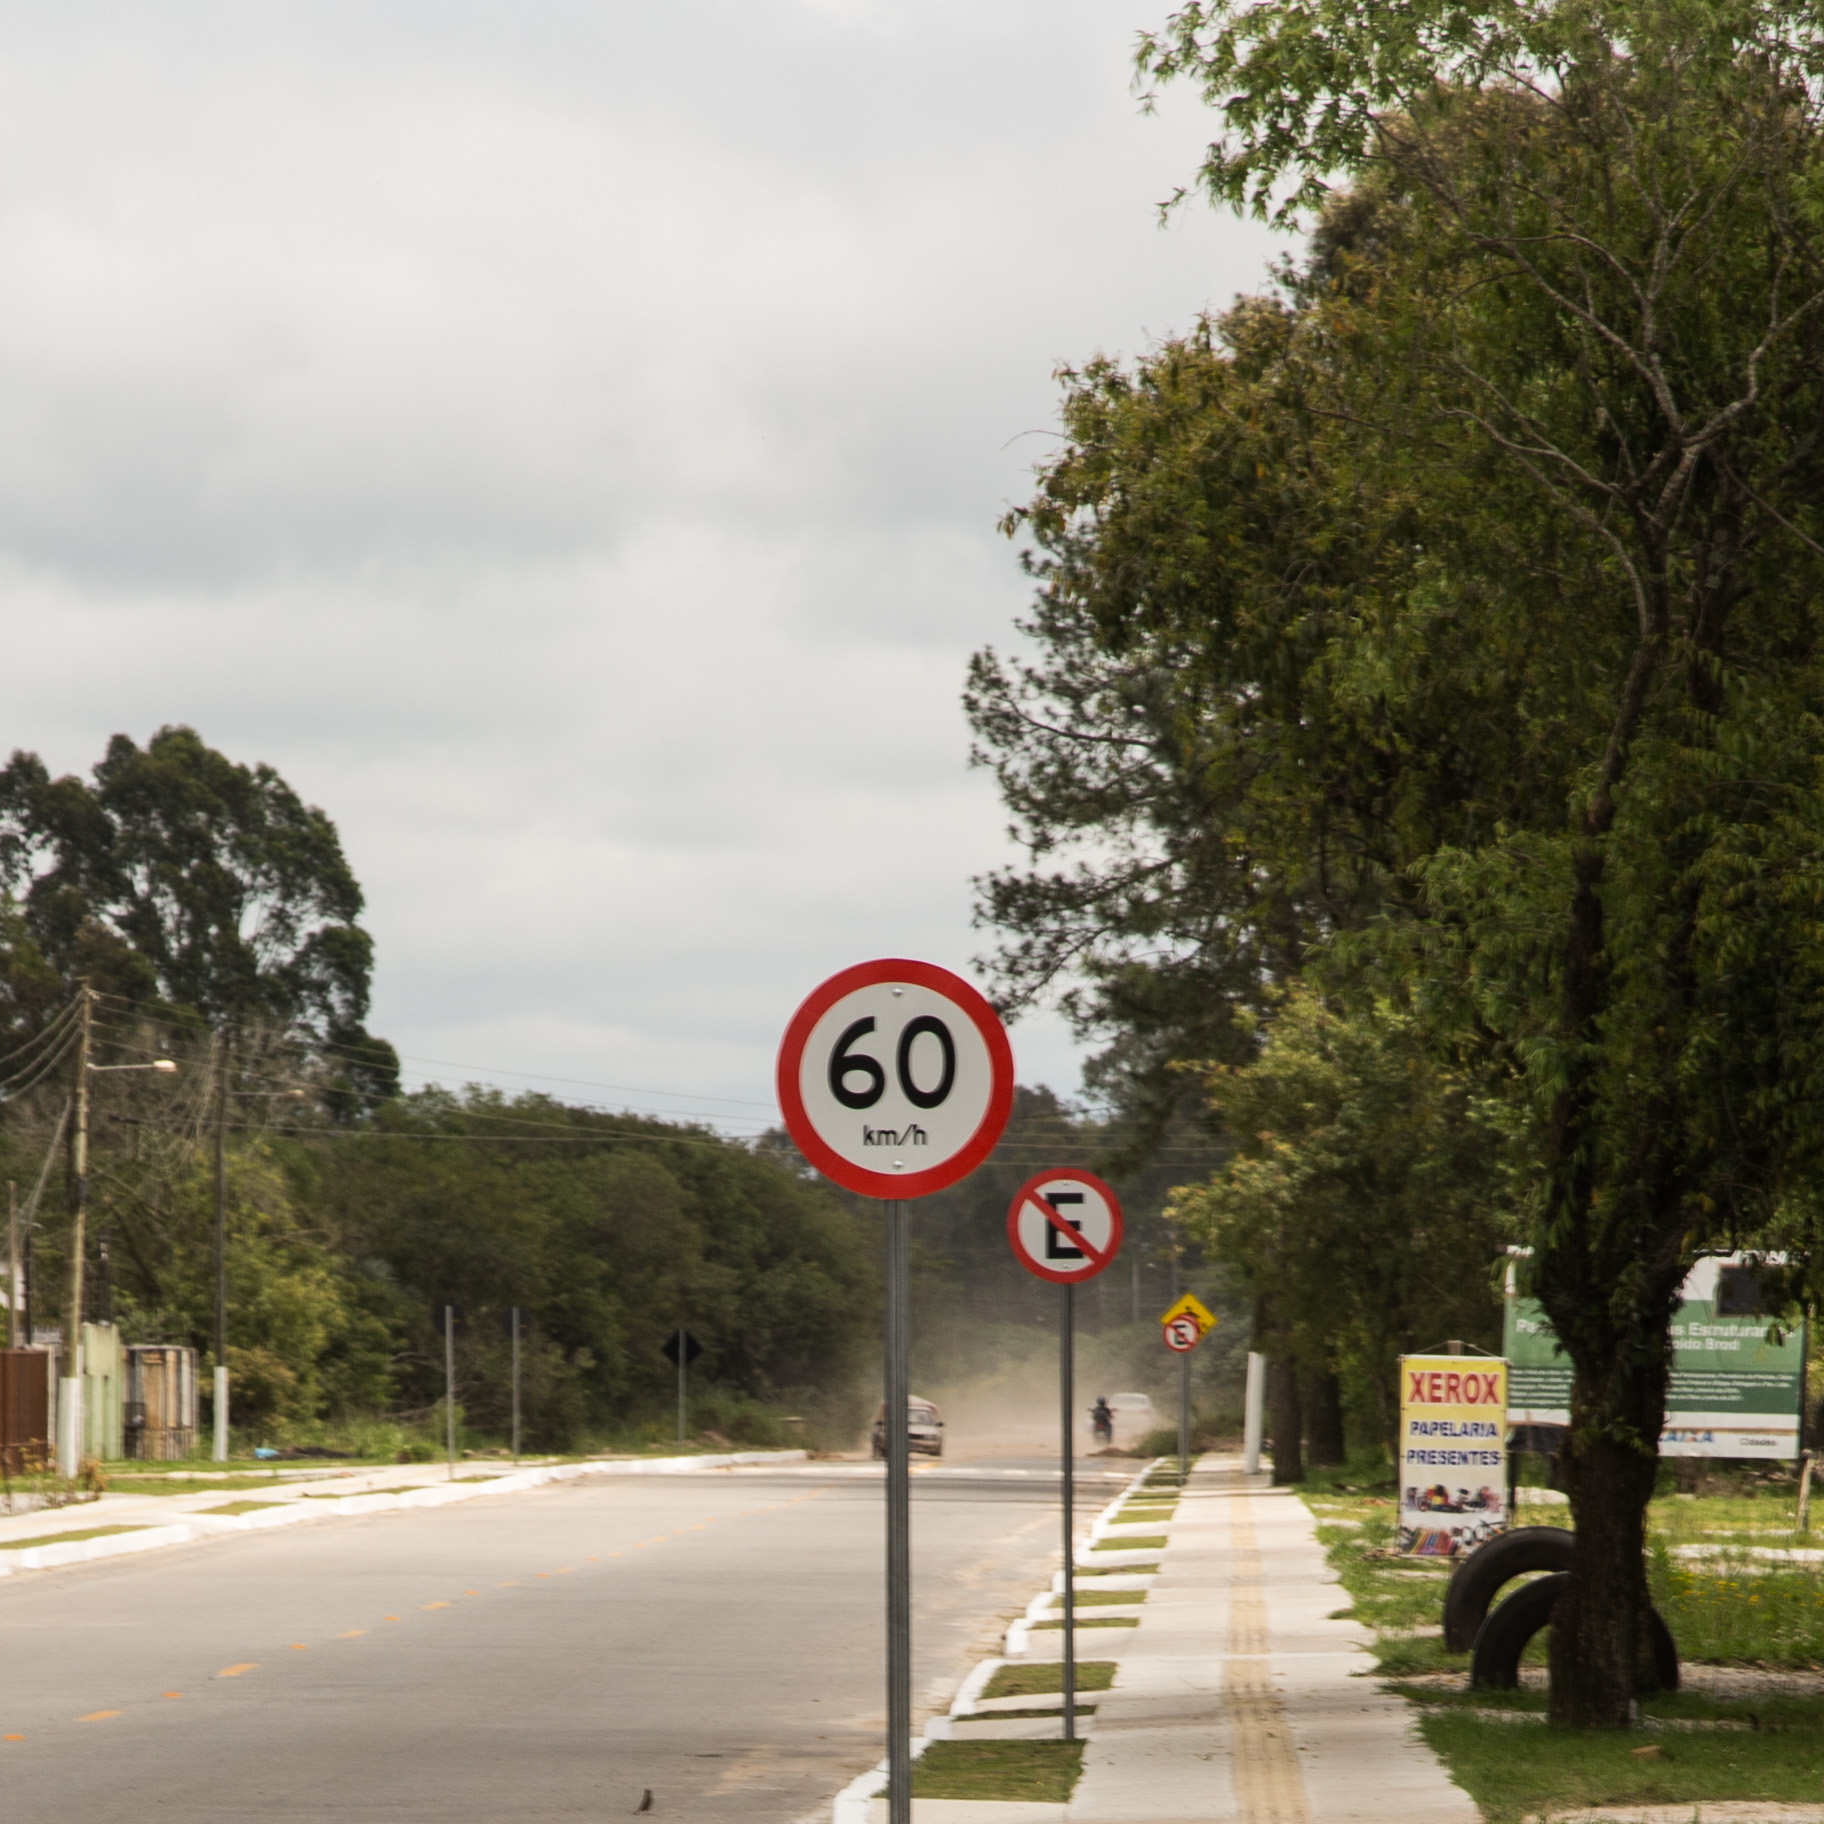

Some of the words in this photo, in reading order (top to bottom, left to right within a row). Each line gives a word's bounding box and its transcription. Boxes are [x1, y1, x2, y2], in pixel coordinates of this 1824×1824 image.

[828, 1015, 956, 1109] 60
[862, 1123, 929, 1146] km/h
[1045, 1192, 1084, 1260] E
[1407, 1371, 1500, 1405] XEROX
[1410, 1421, 1498, 1437] PAPELARIA
[1406, 1449, 1500, 1465] PRESENTES
